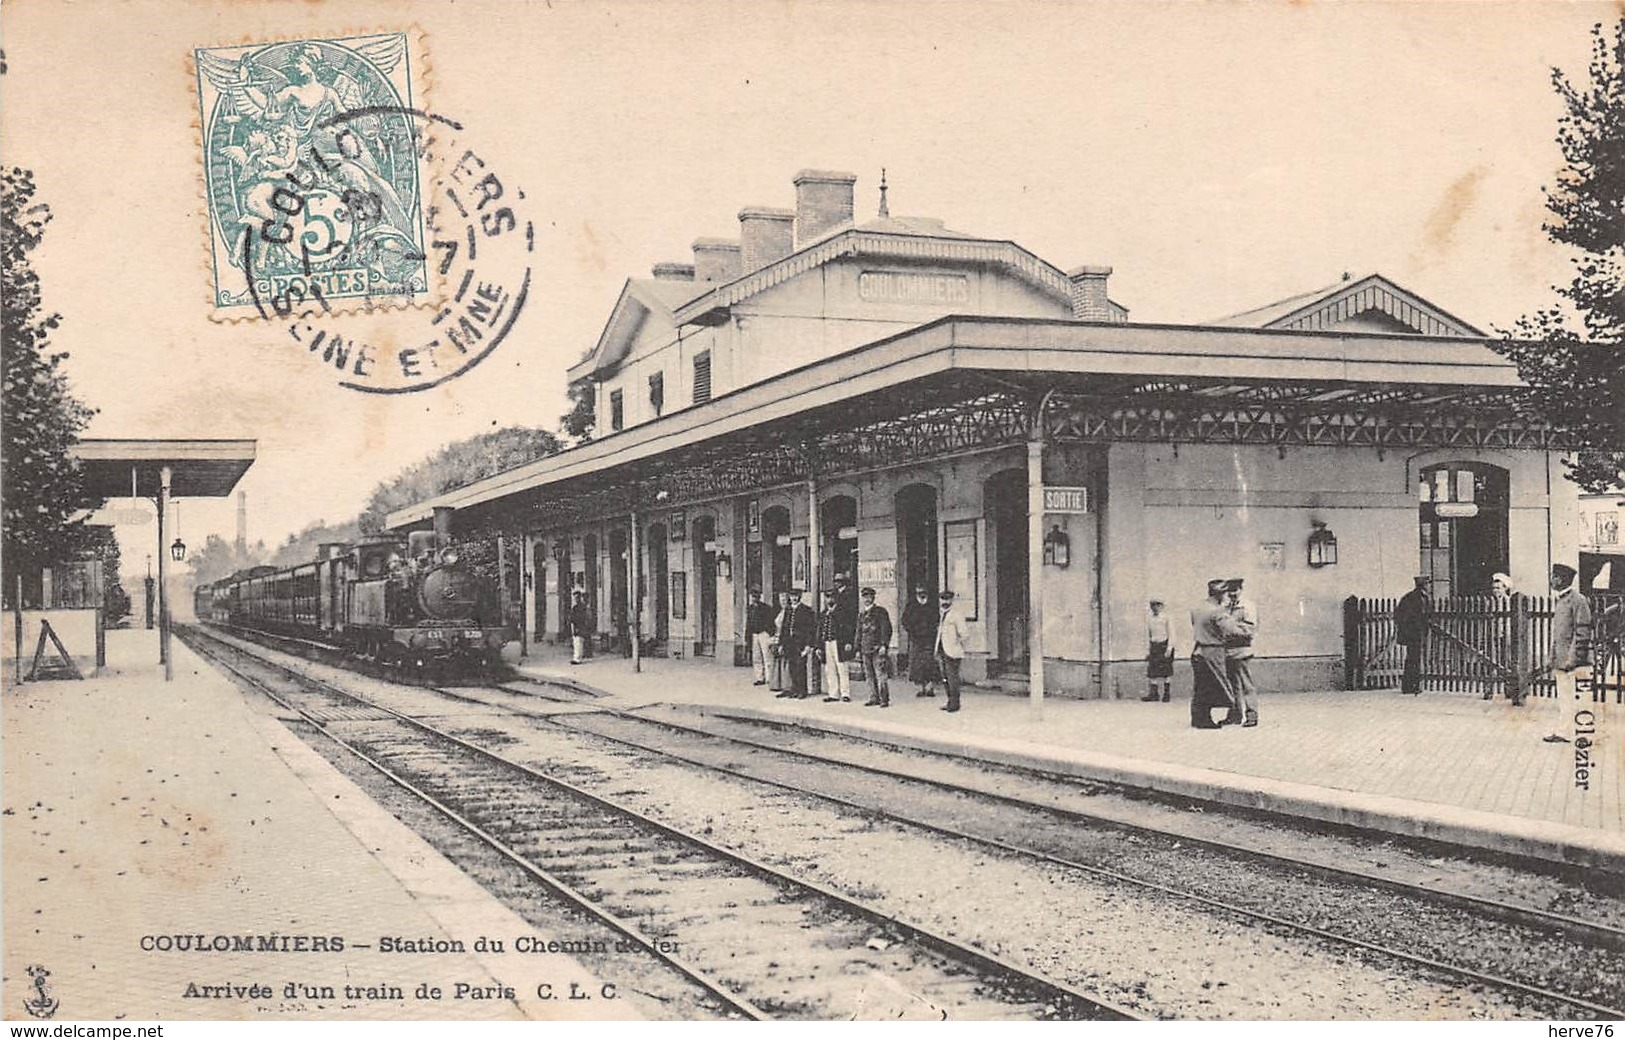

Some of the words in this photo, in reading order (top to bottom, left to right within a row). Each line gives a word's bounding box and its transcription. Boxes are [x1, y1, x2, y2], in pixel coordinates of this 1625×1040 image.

[273, 272, 366, 299] POSTES
[399, 339, 440, 377] ET
[1046, 491, 1083, 509] SORTIE
